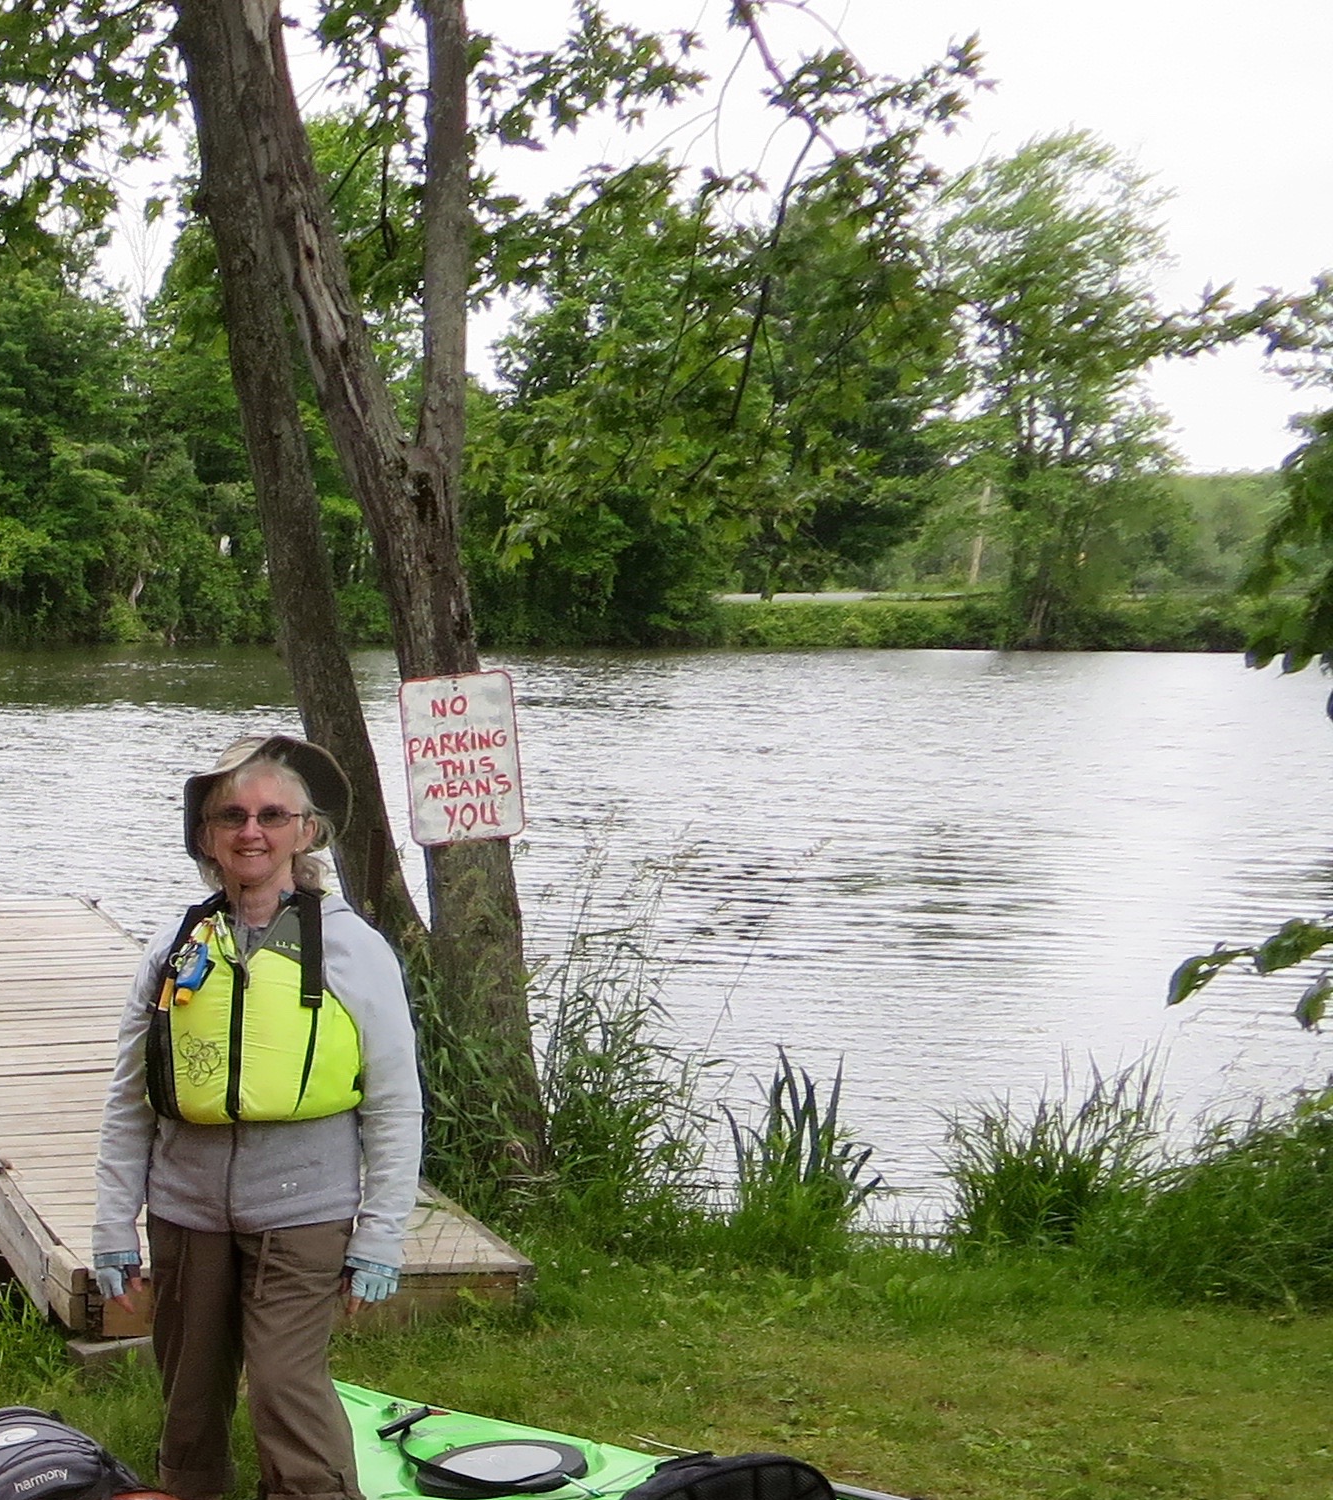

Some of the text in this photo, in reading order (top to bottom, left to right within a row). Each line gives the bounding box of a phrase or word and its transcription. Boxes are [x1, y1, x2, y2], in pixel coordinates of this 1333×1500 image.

[431, 695, 468, 718] NO
[408, 726, 508, 765] PARKING
[436, 756, 496, 780] THIS
[425, 774, 513, 799] MEANS
[443, 800, 500, 834] YOU
[13, 1467, 69, 1494] harmony
